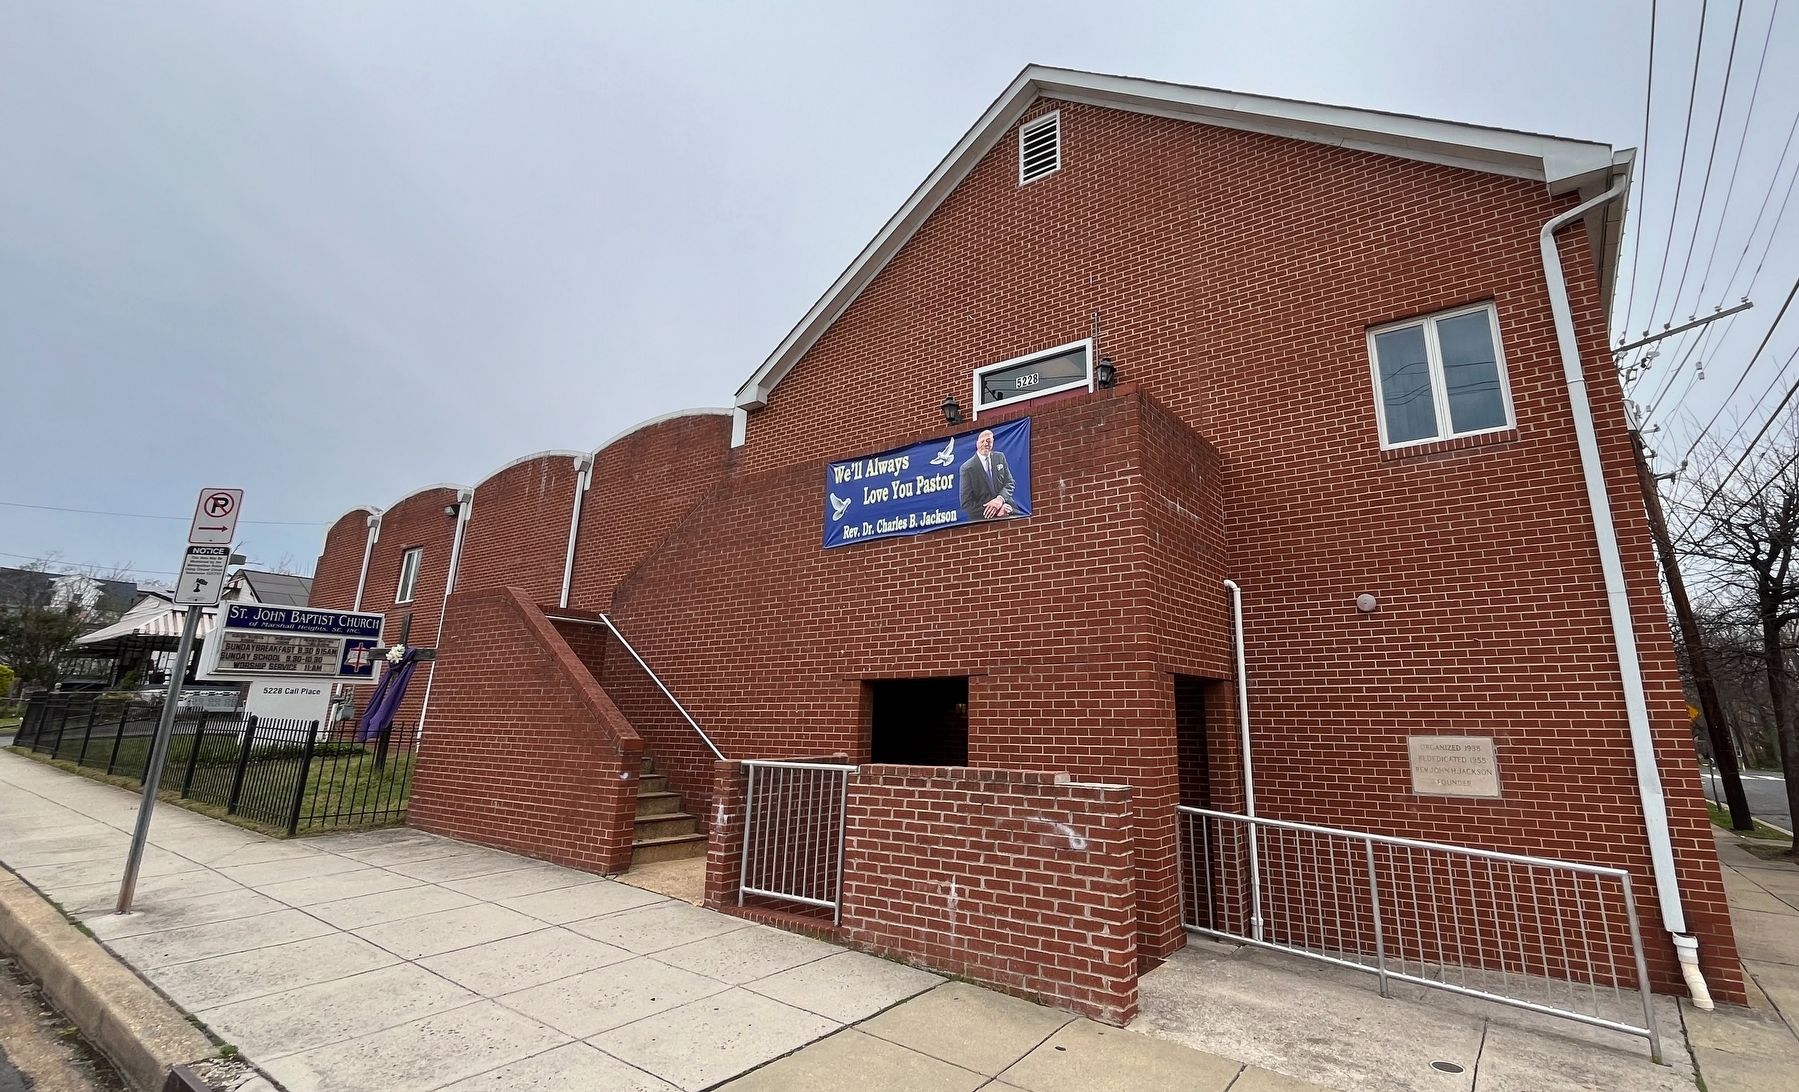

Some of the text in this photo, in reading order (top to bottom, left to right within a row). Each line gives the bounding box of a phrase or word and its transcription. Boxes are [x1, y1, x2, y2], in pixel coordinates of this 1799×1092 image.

[1017, 374, 1038, 388] 5228
[834, 456, 910, 484] We'll Always
[864, 473, 954, 505] Love You Pastor
[842, 509, 958, 540] Rev. Dr. Charles B. Jackson
[253, 608, 286, 622] JOHN
[290, 611, 335, 626] BAPTIST
[338, 615, 380, 629] CHURCH
[221, 652, 250, 660] SUNDAY
[234, 662, 266, 670] WORSHIP
